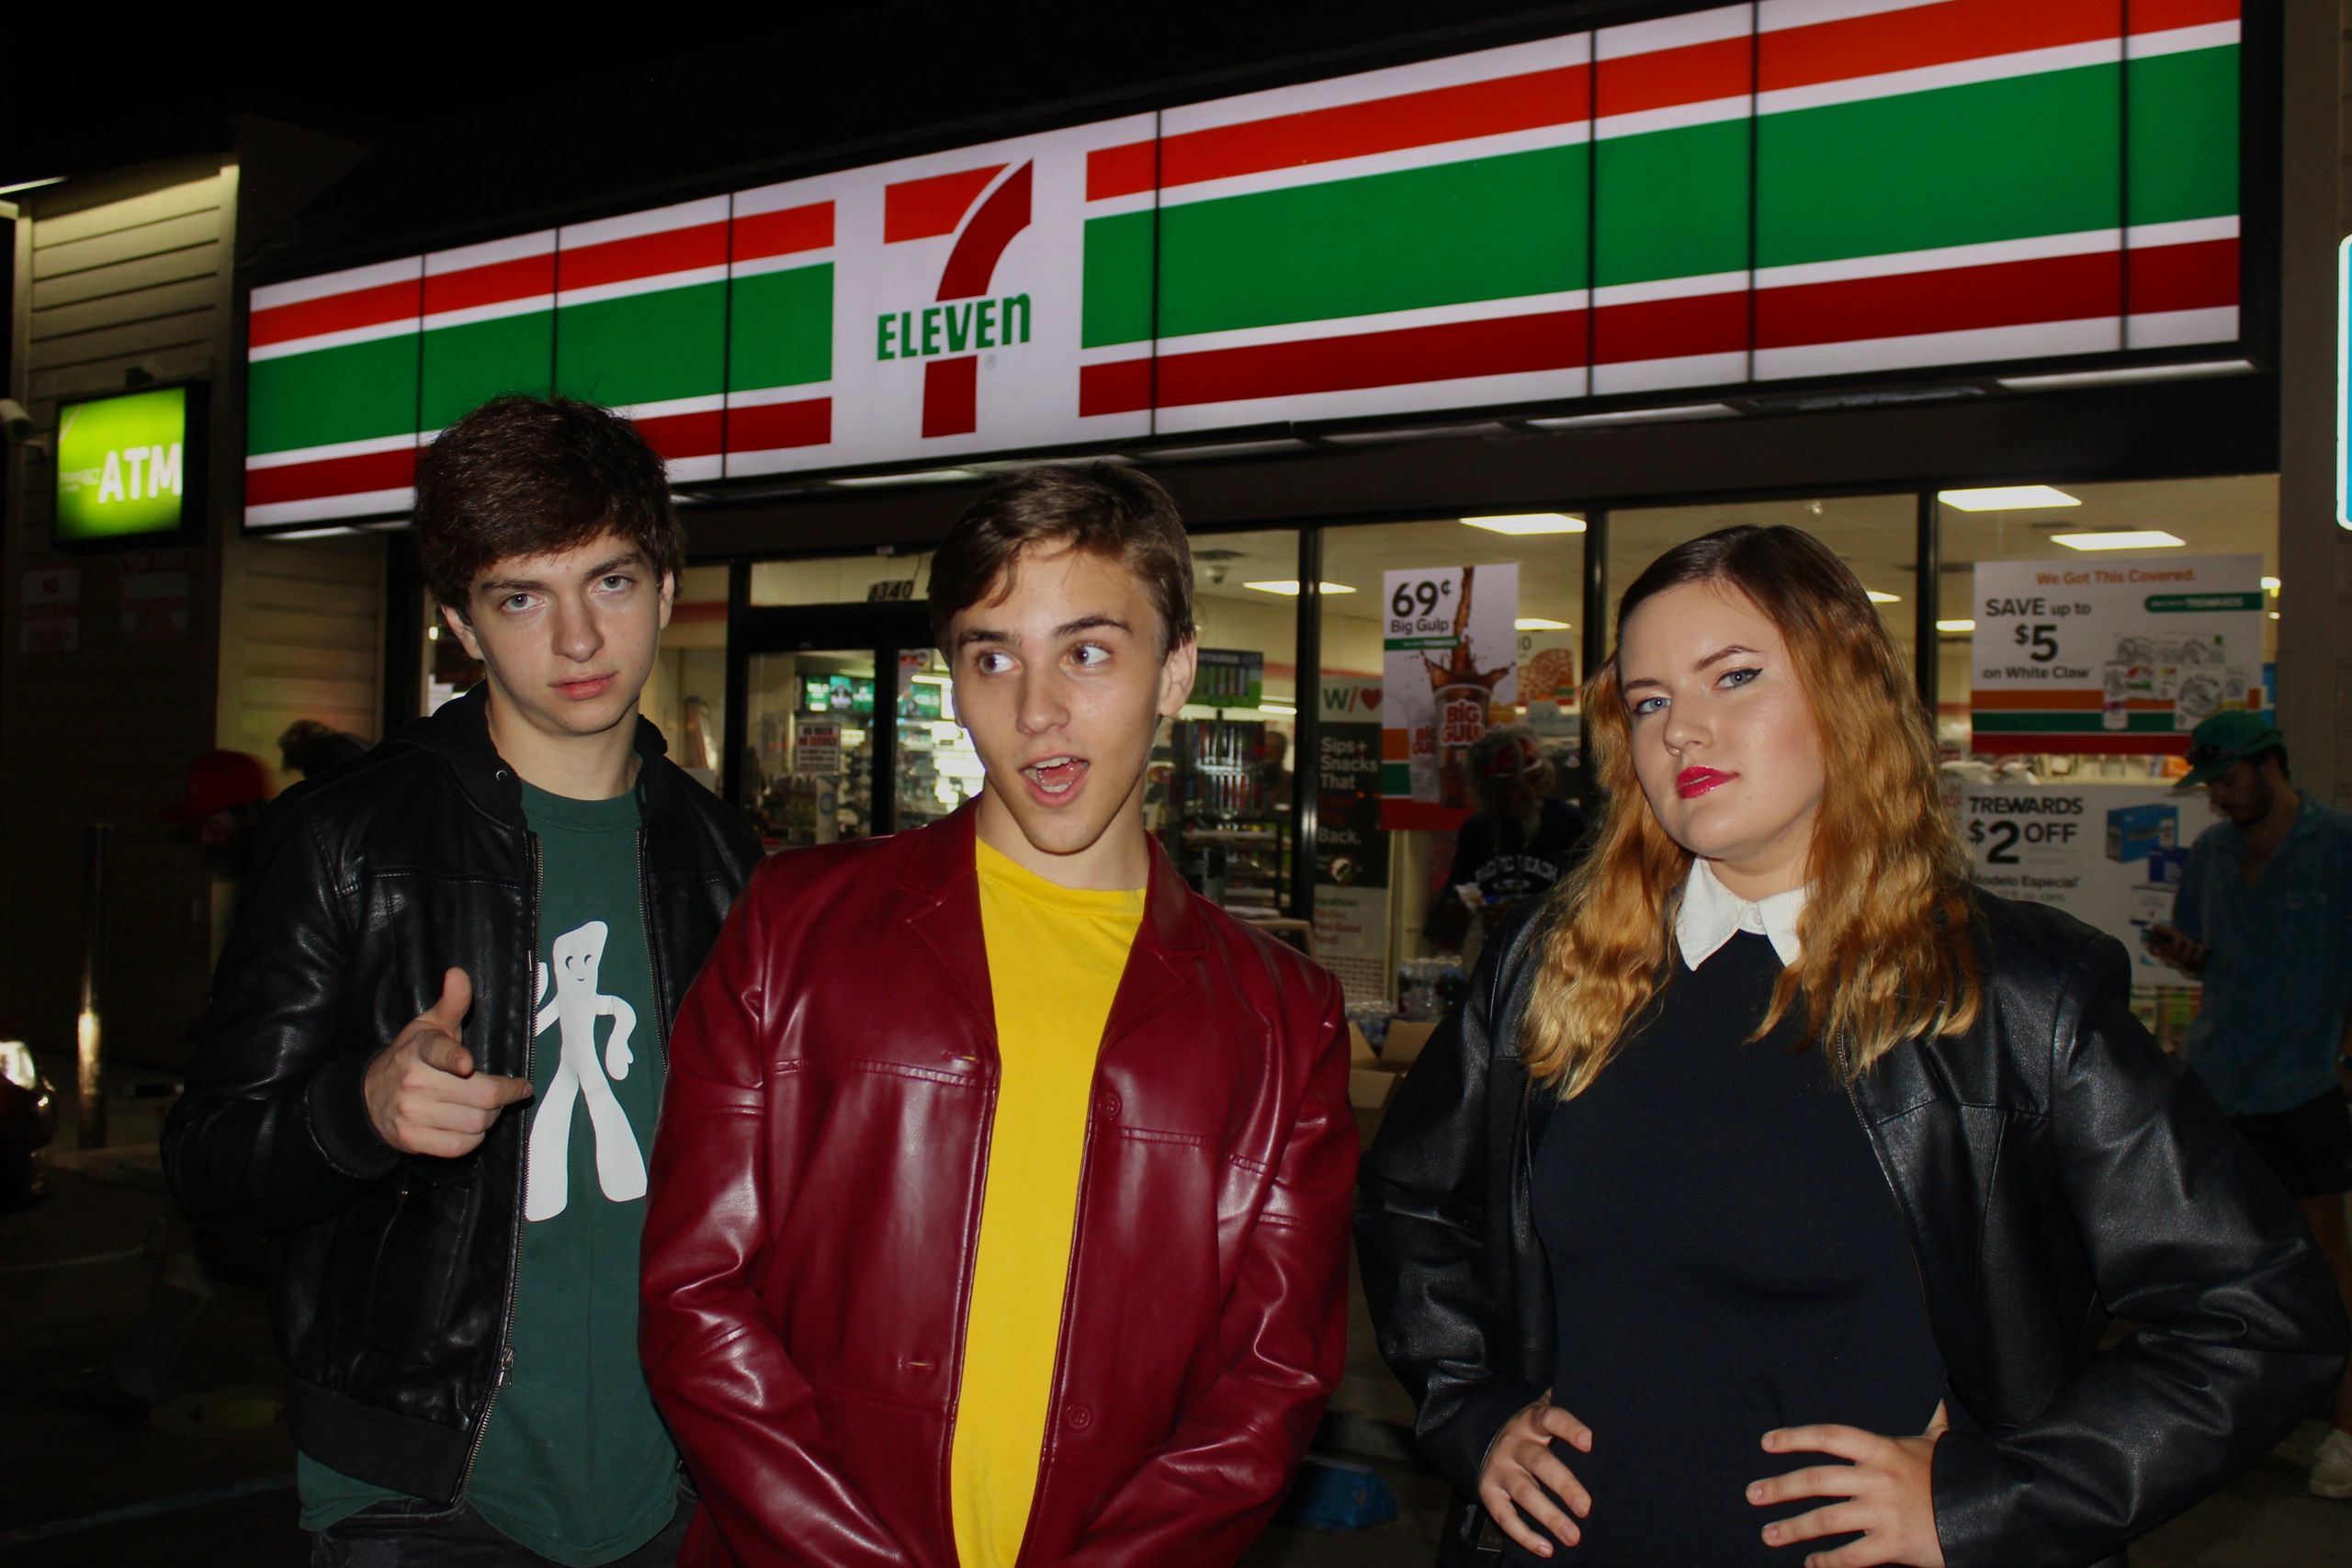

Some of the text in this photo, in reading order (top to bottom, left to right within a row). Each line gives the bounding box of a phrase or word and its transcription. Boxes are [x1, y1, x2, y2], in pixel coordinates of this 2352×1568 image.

[883, 157, 1034, 439] 7
[97, 443, 183, 504] ATM
[2037, 568, 2197, 585] We Got This Covered.
[1985, 598, 2091, 616] SAVE up to
[1391, 618, 1449, 635] Big Gulp
[2016, 624, 2059, 662] $5
[1984, 666, 2089, 680] on White Claw
[1320, 755, 1378, 773] Snacks
[1320, 773, 1356, 790] That
[1969, 796, 2083, 815] 7REWARDS
[1318, 828, 1363, 845] Back.
[1969, 818, 2077, 863] $2 OFF
